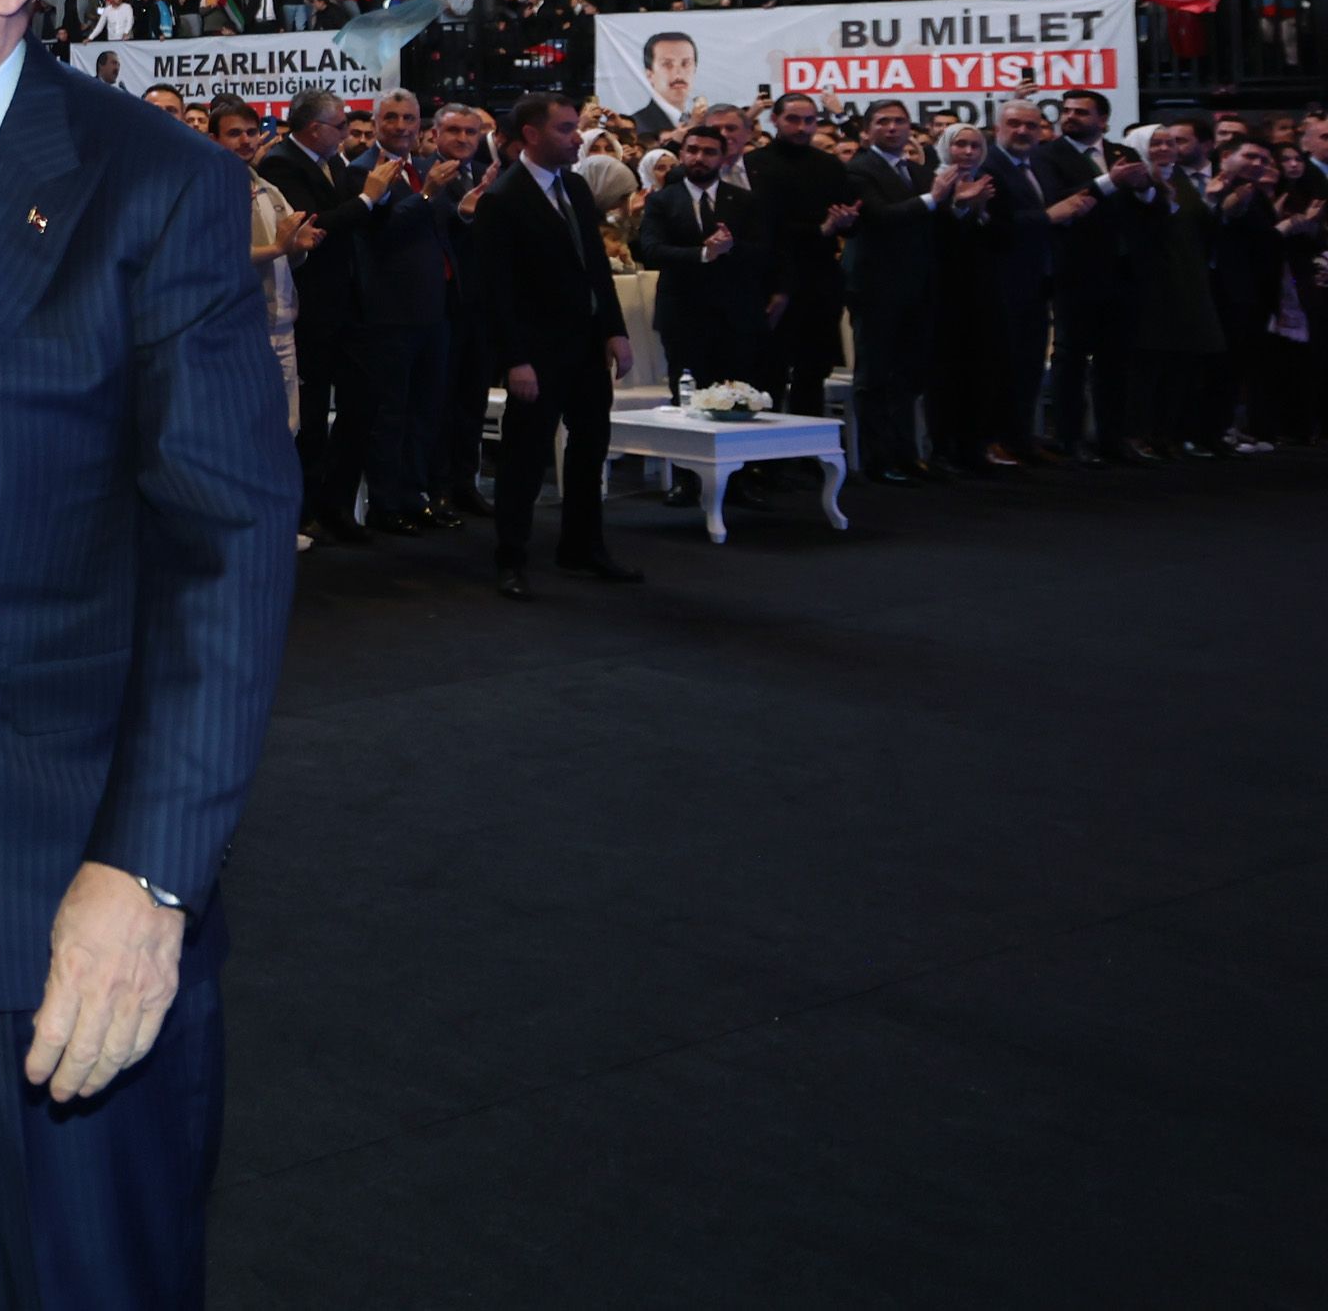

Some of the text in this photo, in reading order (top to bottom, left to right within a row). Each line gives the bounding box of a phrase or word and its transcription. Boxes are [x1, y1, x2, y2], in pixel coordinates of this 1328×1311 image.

[841, 8, 1104, 49] BU MİLLET
[154, 49, 366, 78] MEZARLIKLAR
[787, 57, 915, 90] DAHA
[343, 74, 382, 97] İÇİN
